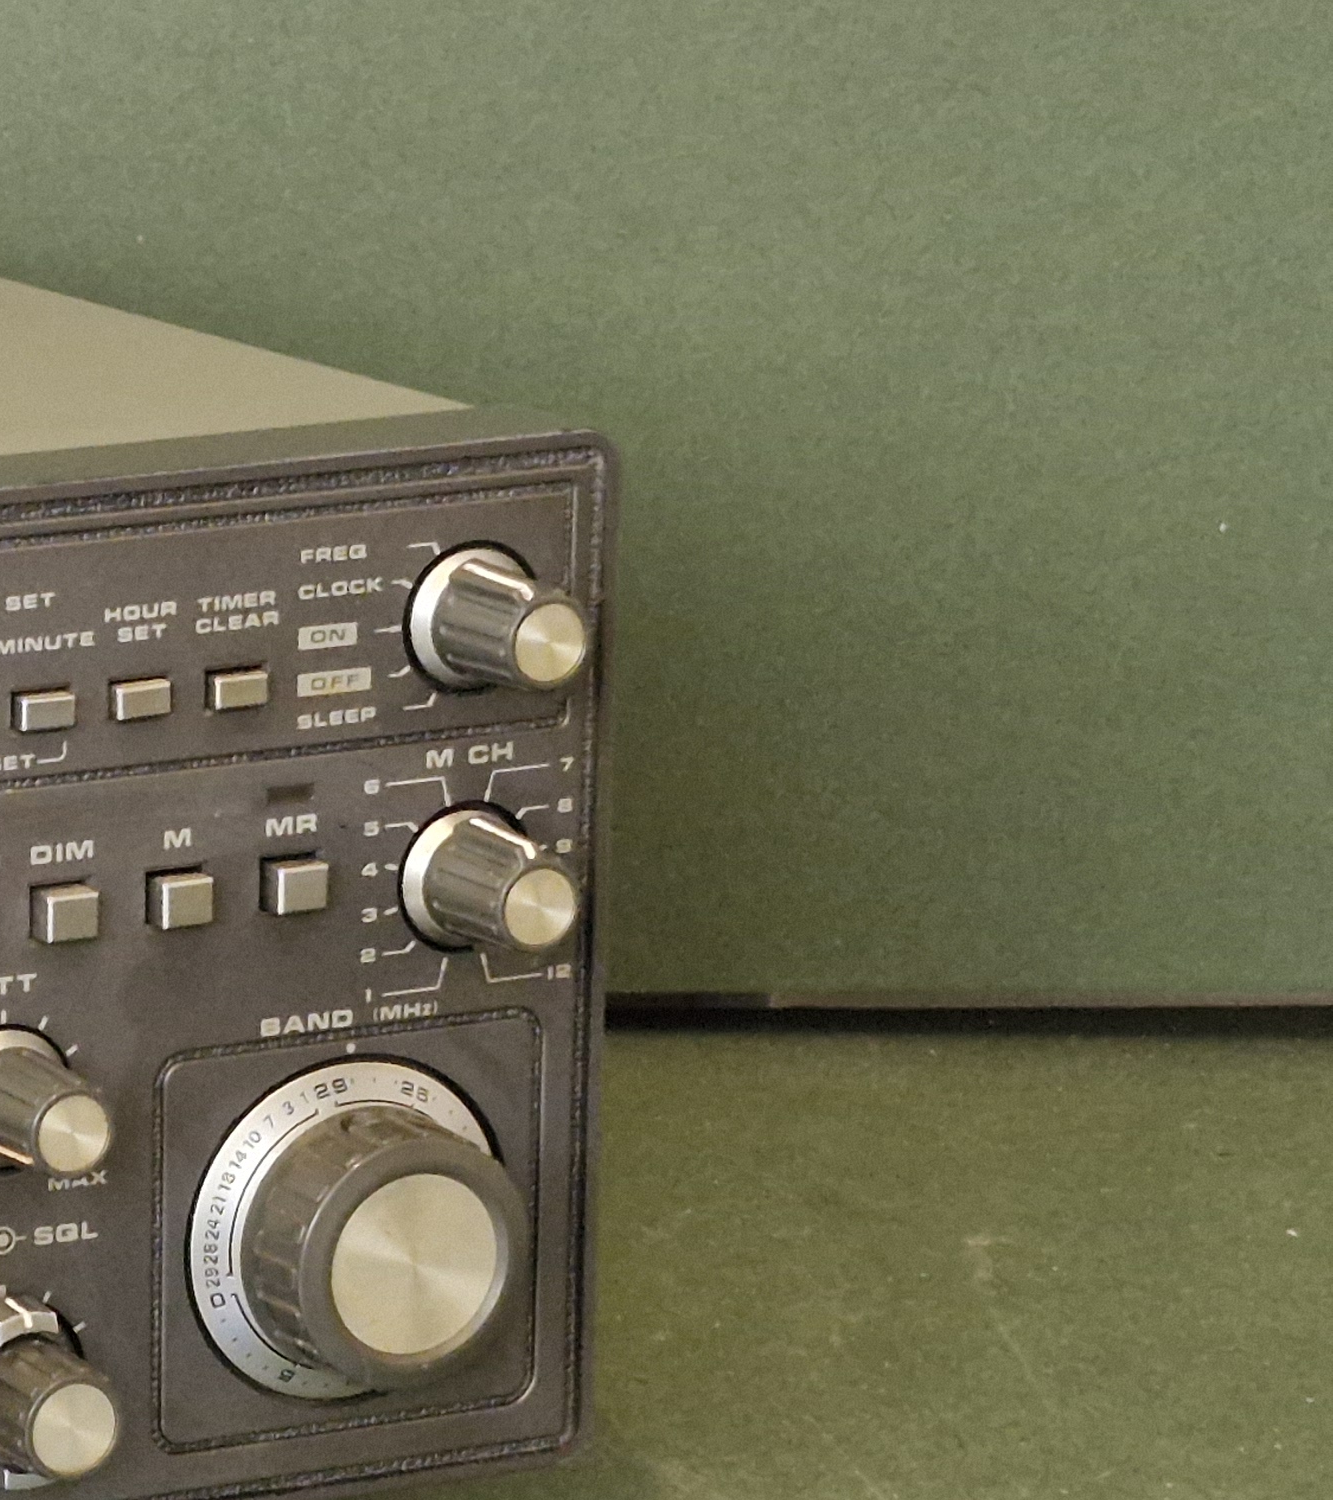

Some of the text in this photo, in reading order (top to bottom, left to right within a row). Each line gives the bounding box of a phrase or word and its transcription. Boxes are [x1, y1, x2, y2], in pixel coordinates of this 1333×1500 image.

[300, 542, 367, 564] FREQ
[298, 577, 383, 600] CLOCK
[6, 592, 56, 611] SET
[104, 601, 178, 622] HOUR
[197, 591, 276, 613] TIMER
[117, 623, 167, 643] SET
[195, 611, 279, 635] CLEAR
[309, 627, 347, 647] ON
[310, 672, 360, 690] OFF
[296, 706, 377, 730] SLEEP
[426, 741, 515, 769] M CH
[559, 756, 575, 772] 7
[265, 812, 318, 838] MR
[164, 828, 192, 849] M
[29, 840, 95, 866] DIM
[361, 862, 378, 877] 4
[361, 907, 378, 923] 3
[360, 947, 376, 963] 2
[547, 963, 572, 981] 12
[259, 1001, 438, 1038] BAND (MHz)
[313, 1078, 348, 1100] 29
[283, 1101, 295, 1116] 3
[264, 1114, 276, 1129] 7
[243, 1130, 263, 1149] 10
[229, 1150, 247, 1170] 14
[47, 1169, 109, 1192] MAX
[33, 1222, 99, 1246] SQL
[204, 1218, 220, 1240] 24
[204, 1266, 220, 1288] 29
